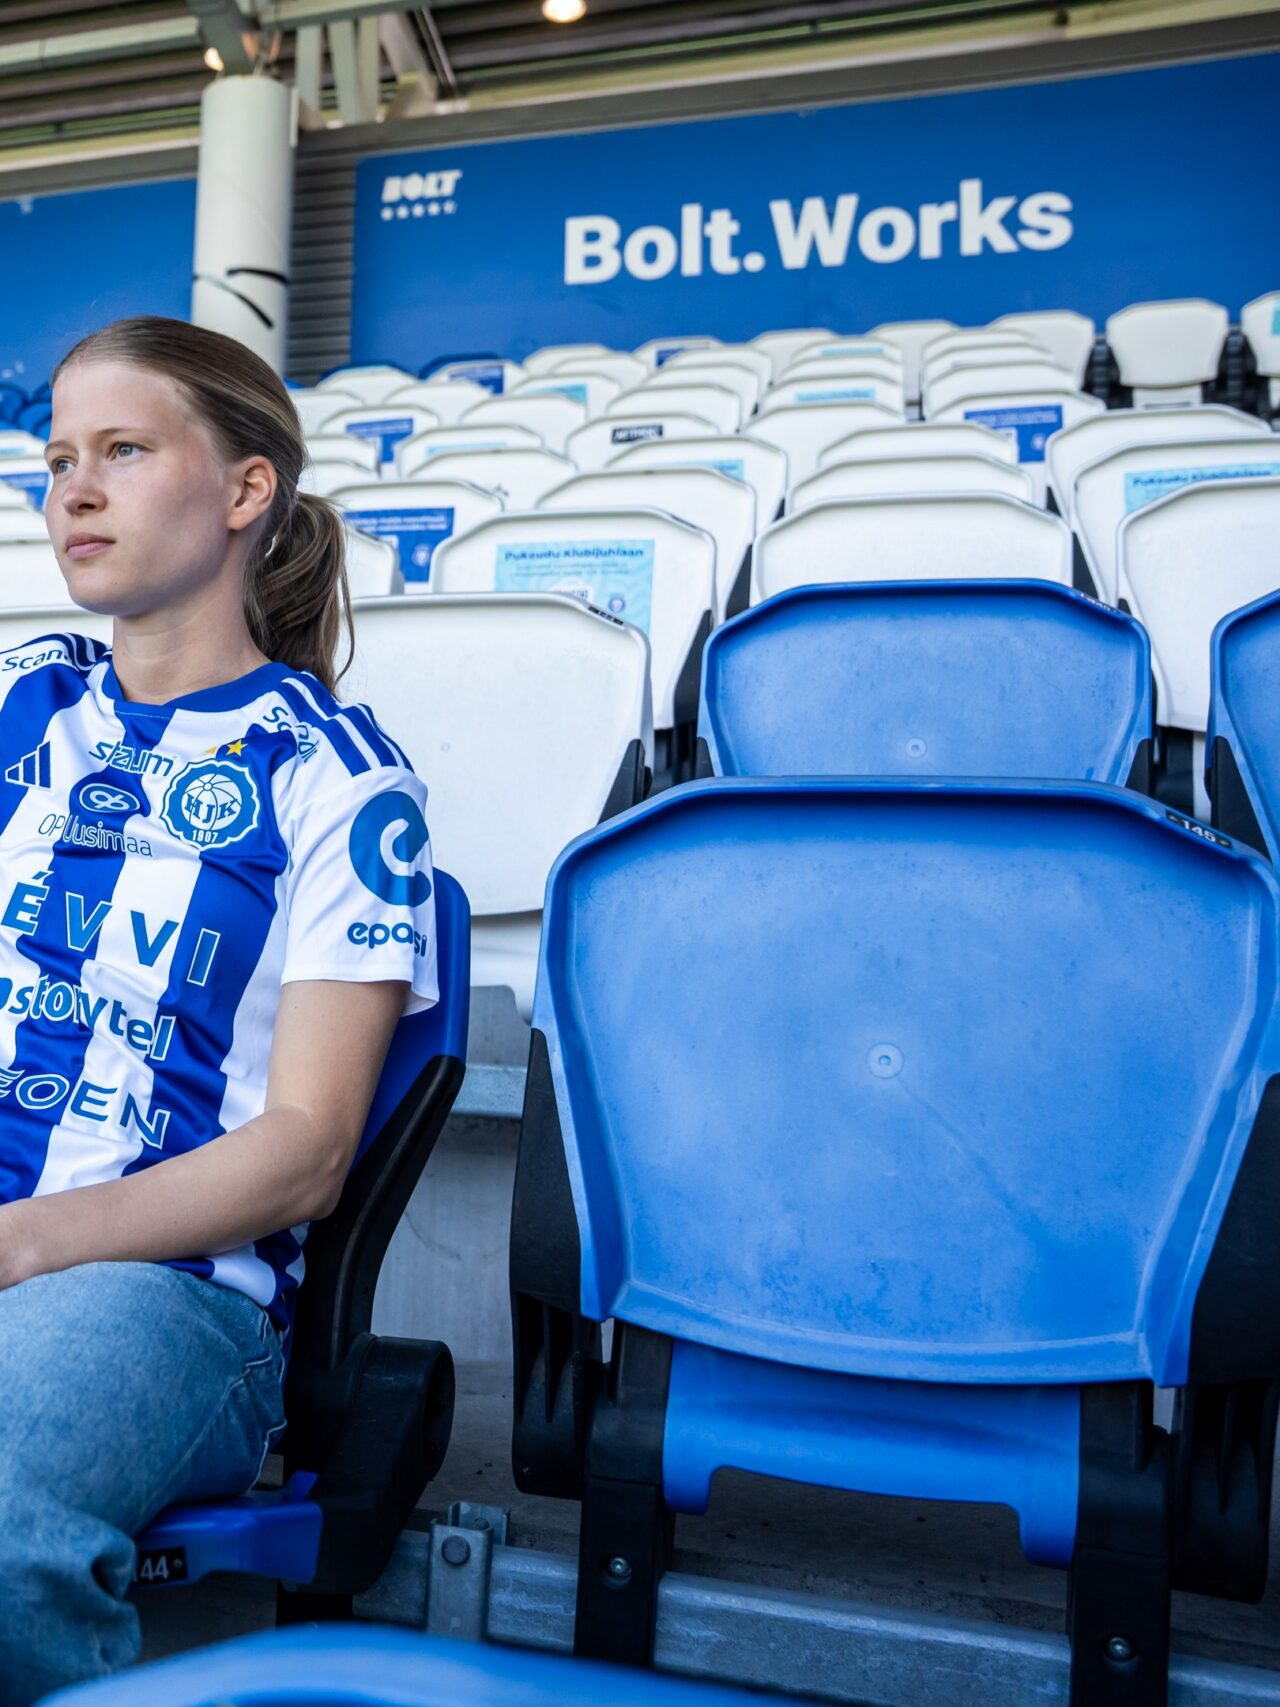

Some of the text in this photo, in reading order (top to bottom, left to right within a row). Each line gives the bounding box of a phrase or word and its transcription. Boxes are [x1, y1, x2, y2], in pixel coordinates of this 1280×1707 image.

[381, 169, 463, 203] BOLT
[564, 178, 1073, 285] Bolt.Works
[1, 649, 66, 672] Scan
[185, 793, 236, 823] HJK
[62, 814, 153, 857] Uusimaa
[192, 829, 218, 843] 1907
[1183, 819, 1217, 842] 145
[133, 1555, 169, 1582] 44
